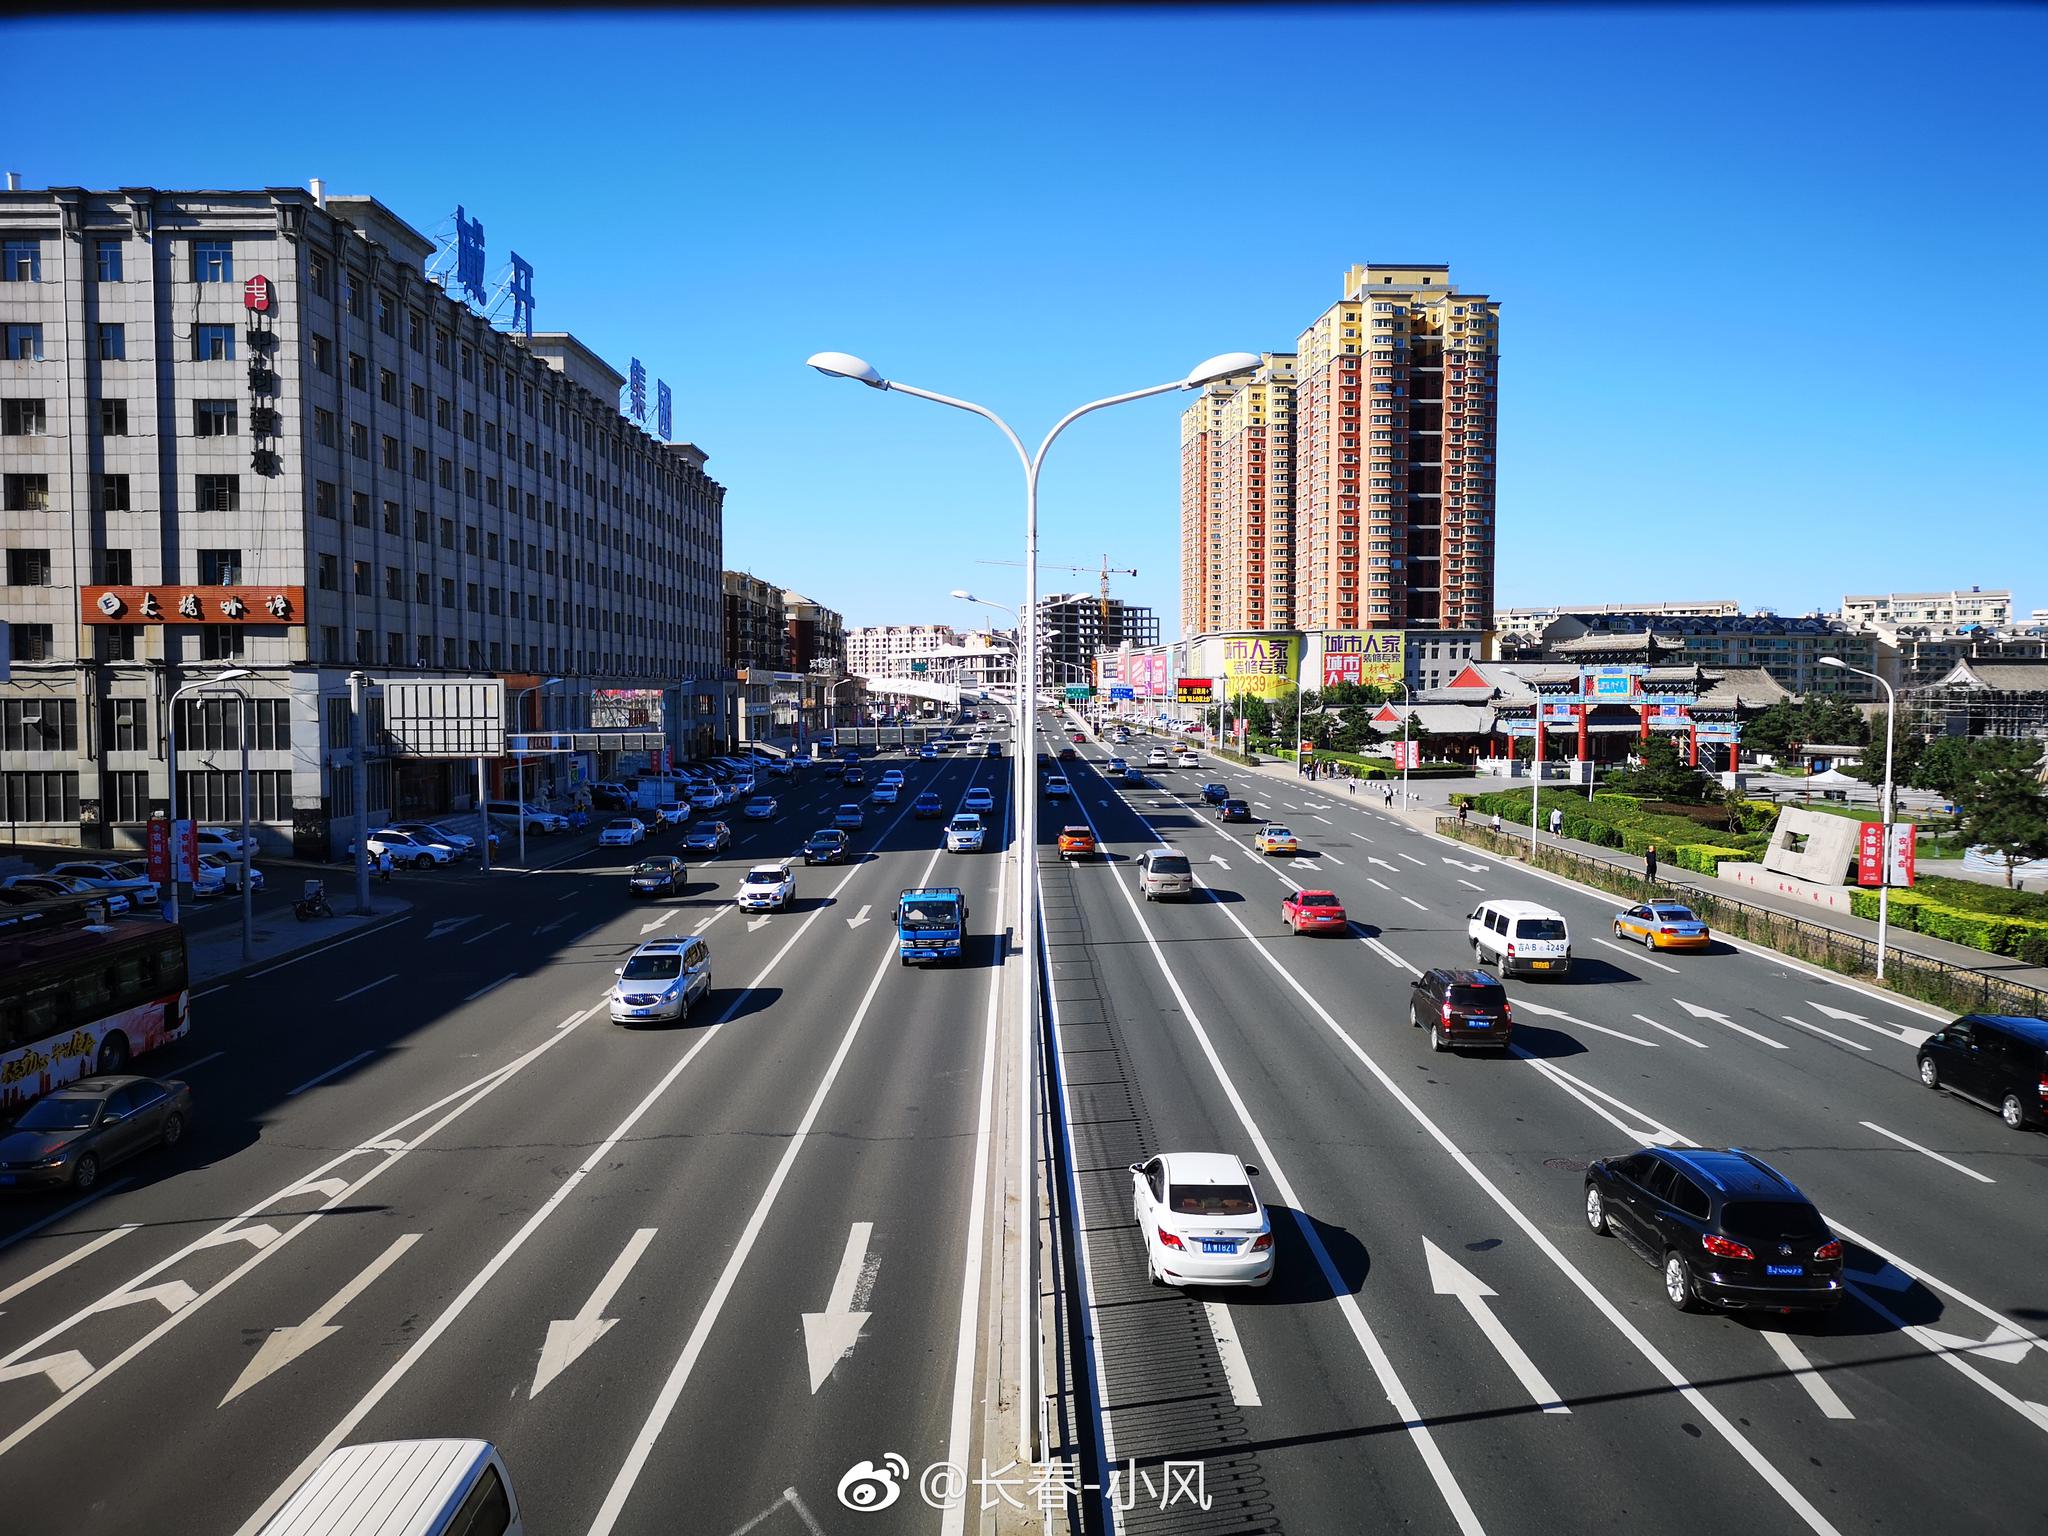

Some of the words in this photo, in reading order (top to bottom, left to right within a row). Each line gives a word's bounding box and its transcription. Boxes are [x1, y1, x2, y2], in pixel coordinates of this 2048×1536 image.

[1224, 639, 1289, 660] 城市人家
[1325, 635, 1400, 653] 城市人家
[1234, 660, 1288, 675] 装修专家
[1325, 655, 1360, 671] 城市
